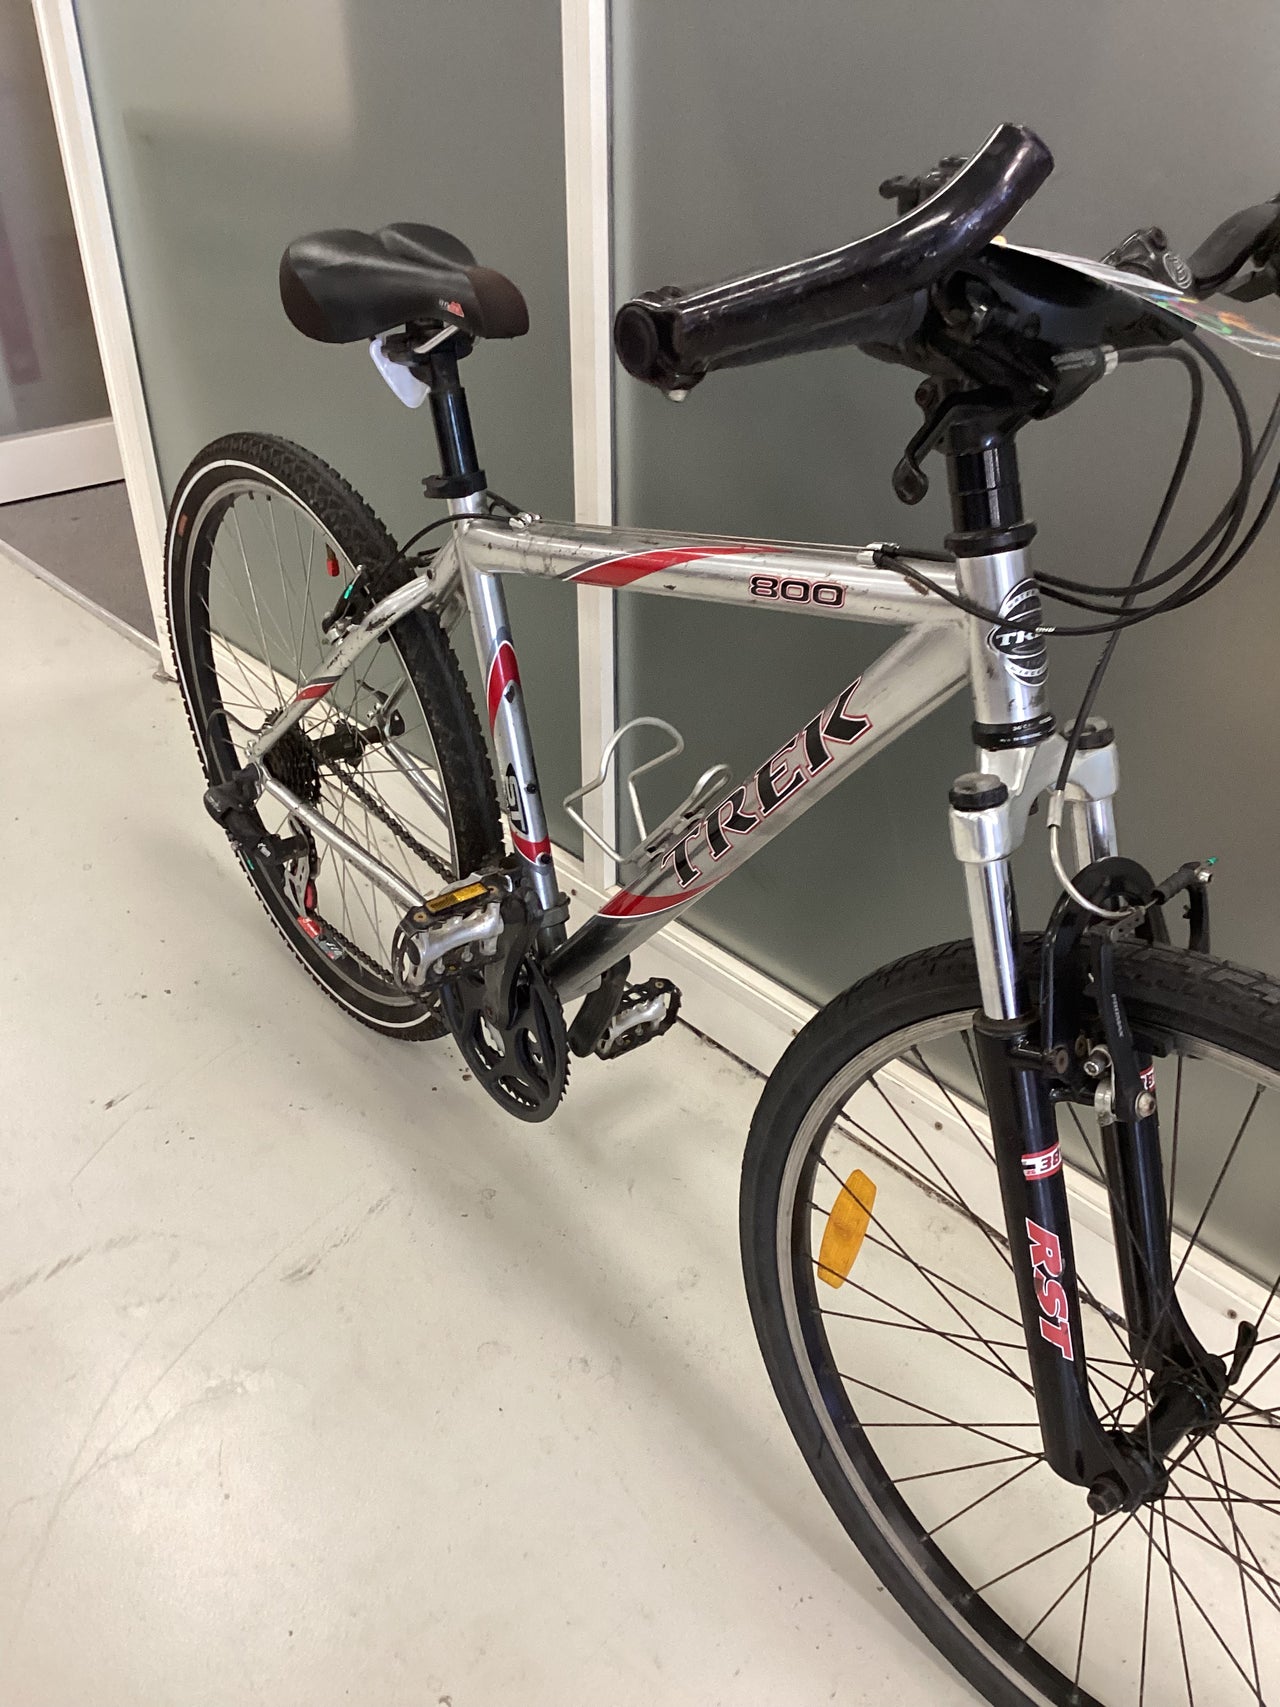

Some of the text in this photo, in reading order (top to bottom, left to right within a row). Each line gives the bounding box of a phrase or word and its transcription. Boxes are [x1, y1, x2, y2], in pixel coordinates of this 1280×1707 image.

[749, 573, 846, 608] 800
[660, 675, 873, 889] TREK
[1025, 1216, 1074, 1362] RST
